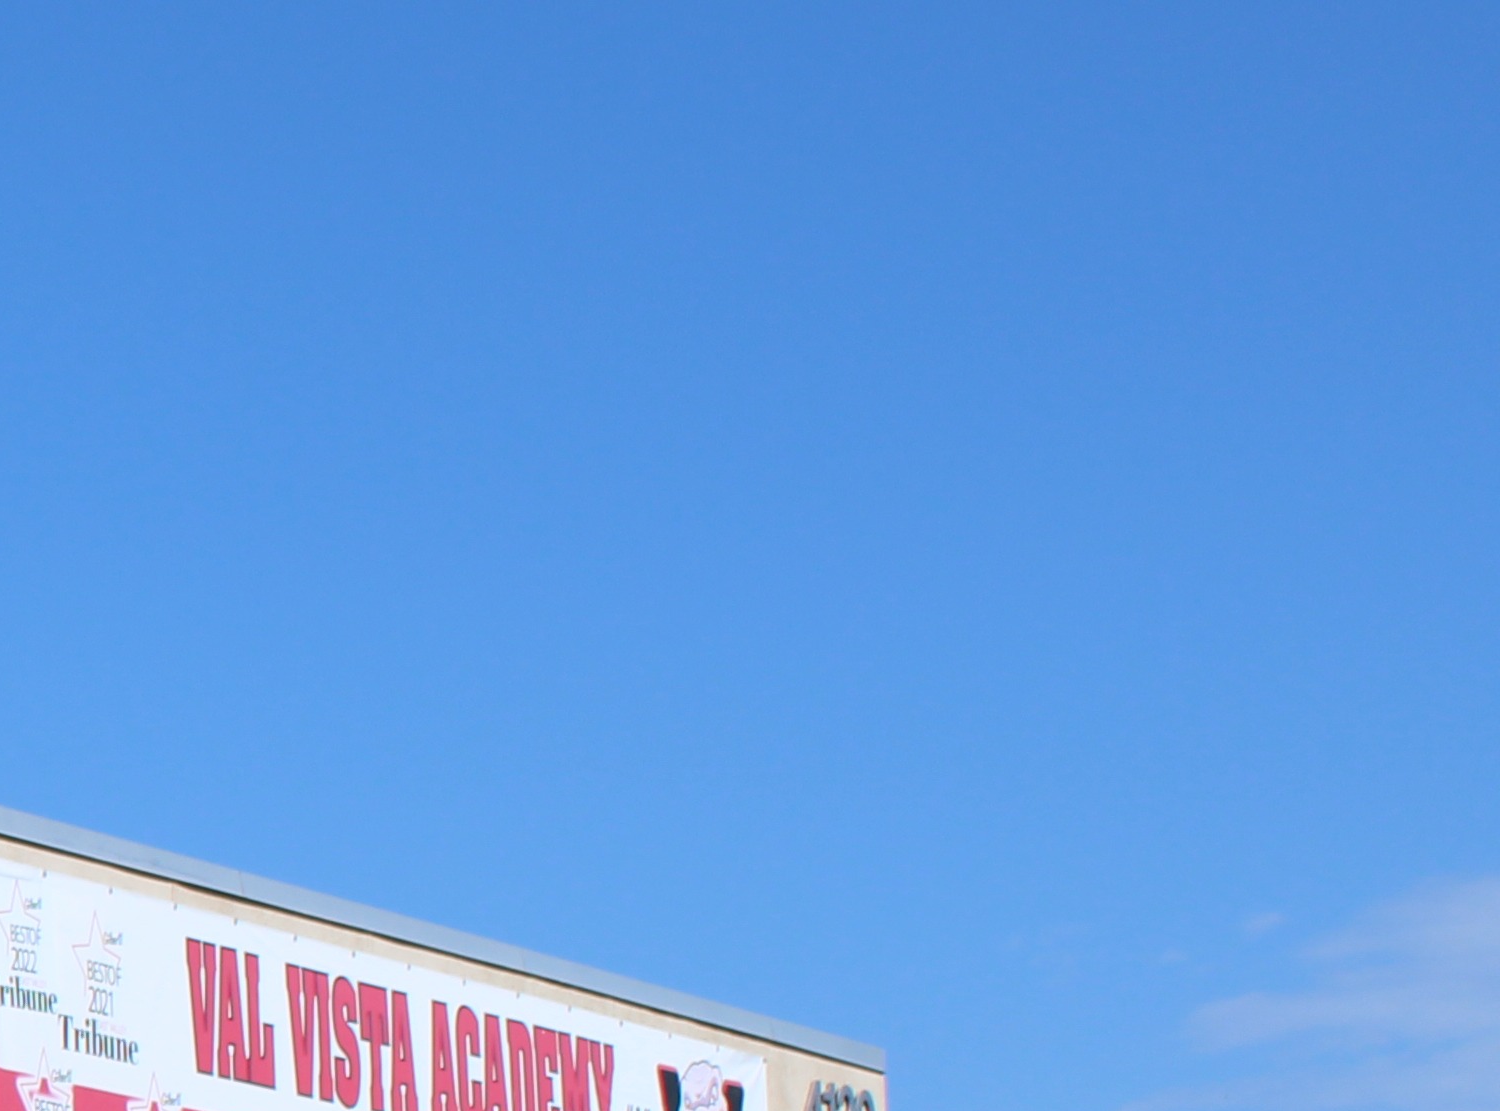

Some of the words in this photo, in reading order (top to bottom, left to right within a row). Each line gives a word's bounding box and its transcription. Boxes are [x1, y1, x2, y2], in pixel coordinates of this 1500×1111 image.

[11, 947, 38, 974] 2022
[88, 986, 114, 1017] 2021
[185, 937, 276, 1090] VAL
[58, 1013, 139, 1066] Tribune
